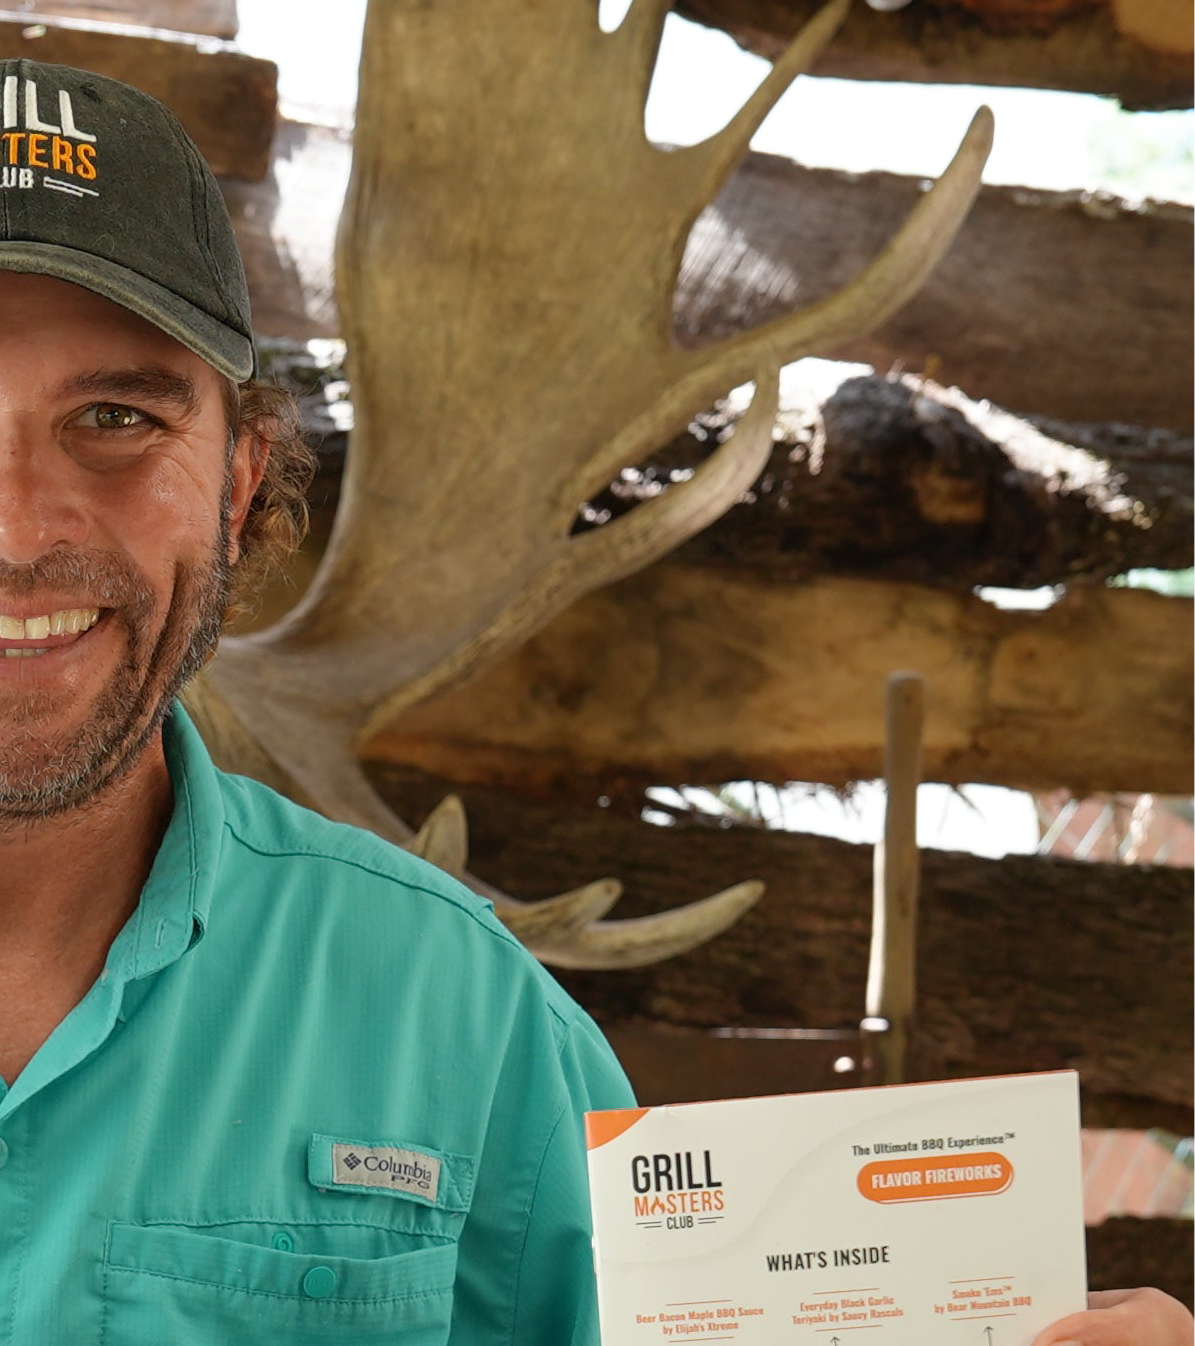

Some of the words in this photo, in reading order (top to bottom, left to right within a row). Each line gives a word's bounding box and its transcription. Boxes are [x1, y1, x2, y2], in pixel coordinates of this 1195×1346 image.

[852, 1145, 870, 1156] The
[873, 1142, 918, 1154] Ultimate
[921, 1138, 943, 1151] BBQ
[364, 1156, 432, 1182] Columbia
[631, 1150, 722, 1194] GRILL
[871, 1171, 922, 1189] FLAVOR
[925, 1164, 1002, 1185] FIREWORKS
[391, 1175, 430, 1190] PFG
[666, 1215, 694, 1230] CLUB
[767, 1251, 827, 1273] WHAT'S
[833, 1245, 890, 1267] INSIDE
[800, 1301, 838, 1312] Everyday
[841, 1298, 866, 1308] Black
[636, 1314, 656, 1324] Beer
[659, 1312, 686, 1323] Bacon
[688, 1310, 714, 1322] Maple
[716, 1308, 736, 1319] BBQ
[738, 1306, 764, 1316] Sauce
[829, 1313, 839, 1322] by
[662, 1325, 674, 1335] by
